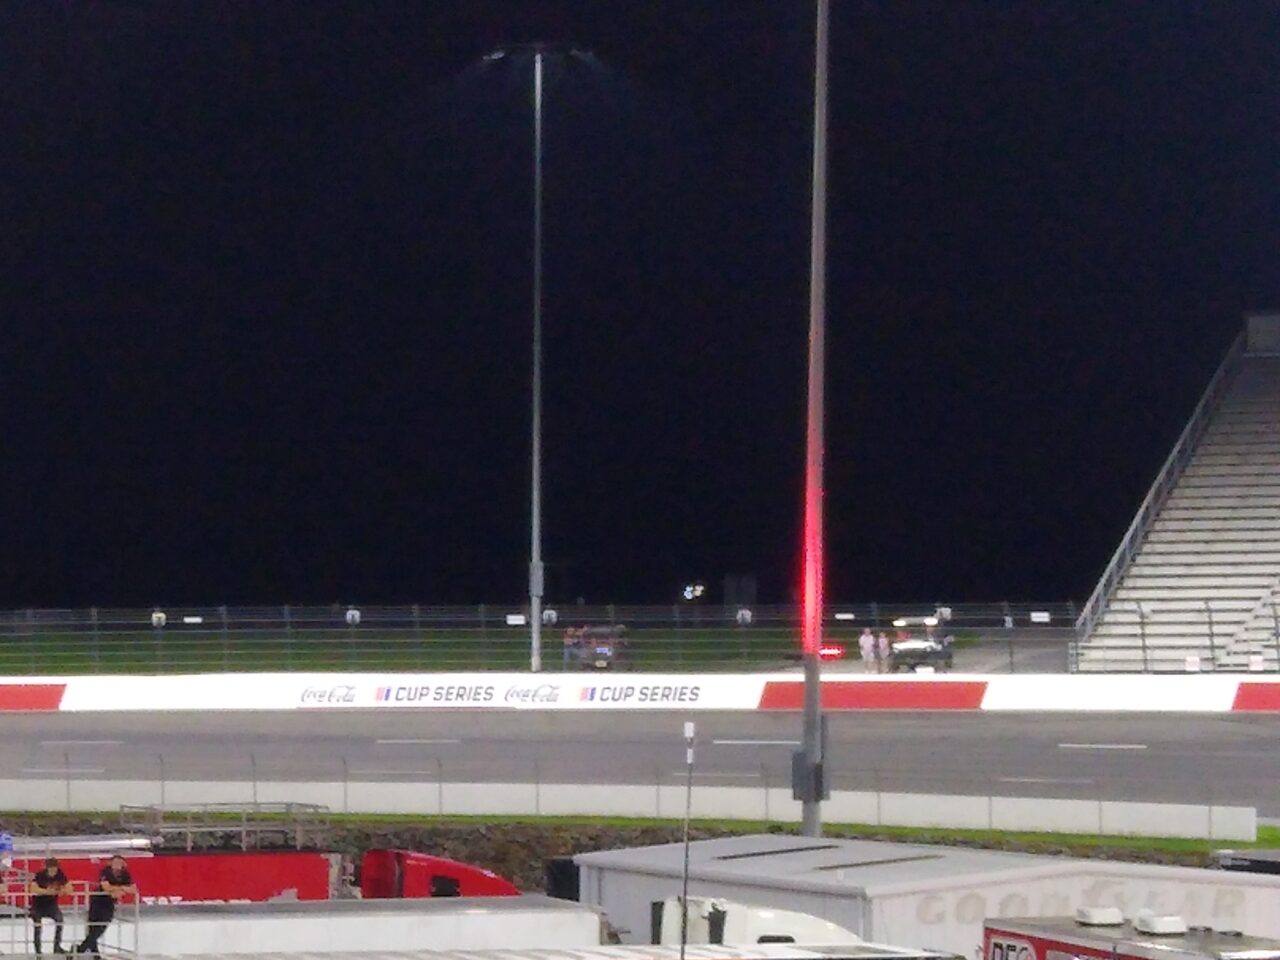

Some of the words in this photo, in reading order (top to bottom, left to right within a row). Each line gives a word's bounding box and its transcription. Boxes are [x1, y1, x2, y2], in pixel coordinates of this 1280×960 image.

[395, 687, 429, 702] CUP
[433, 686, 494, 702] SERIES
[599, 687, 634, 702] CUP
[638, 686, 700, 702] SERIES
